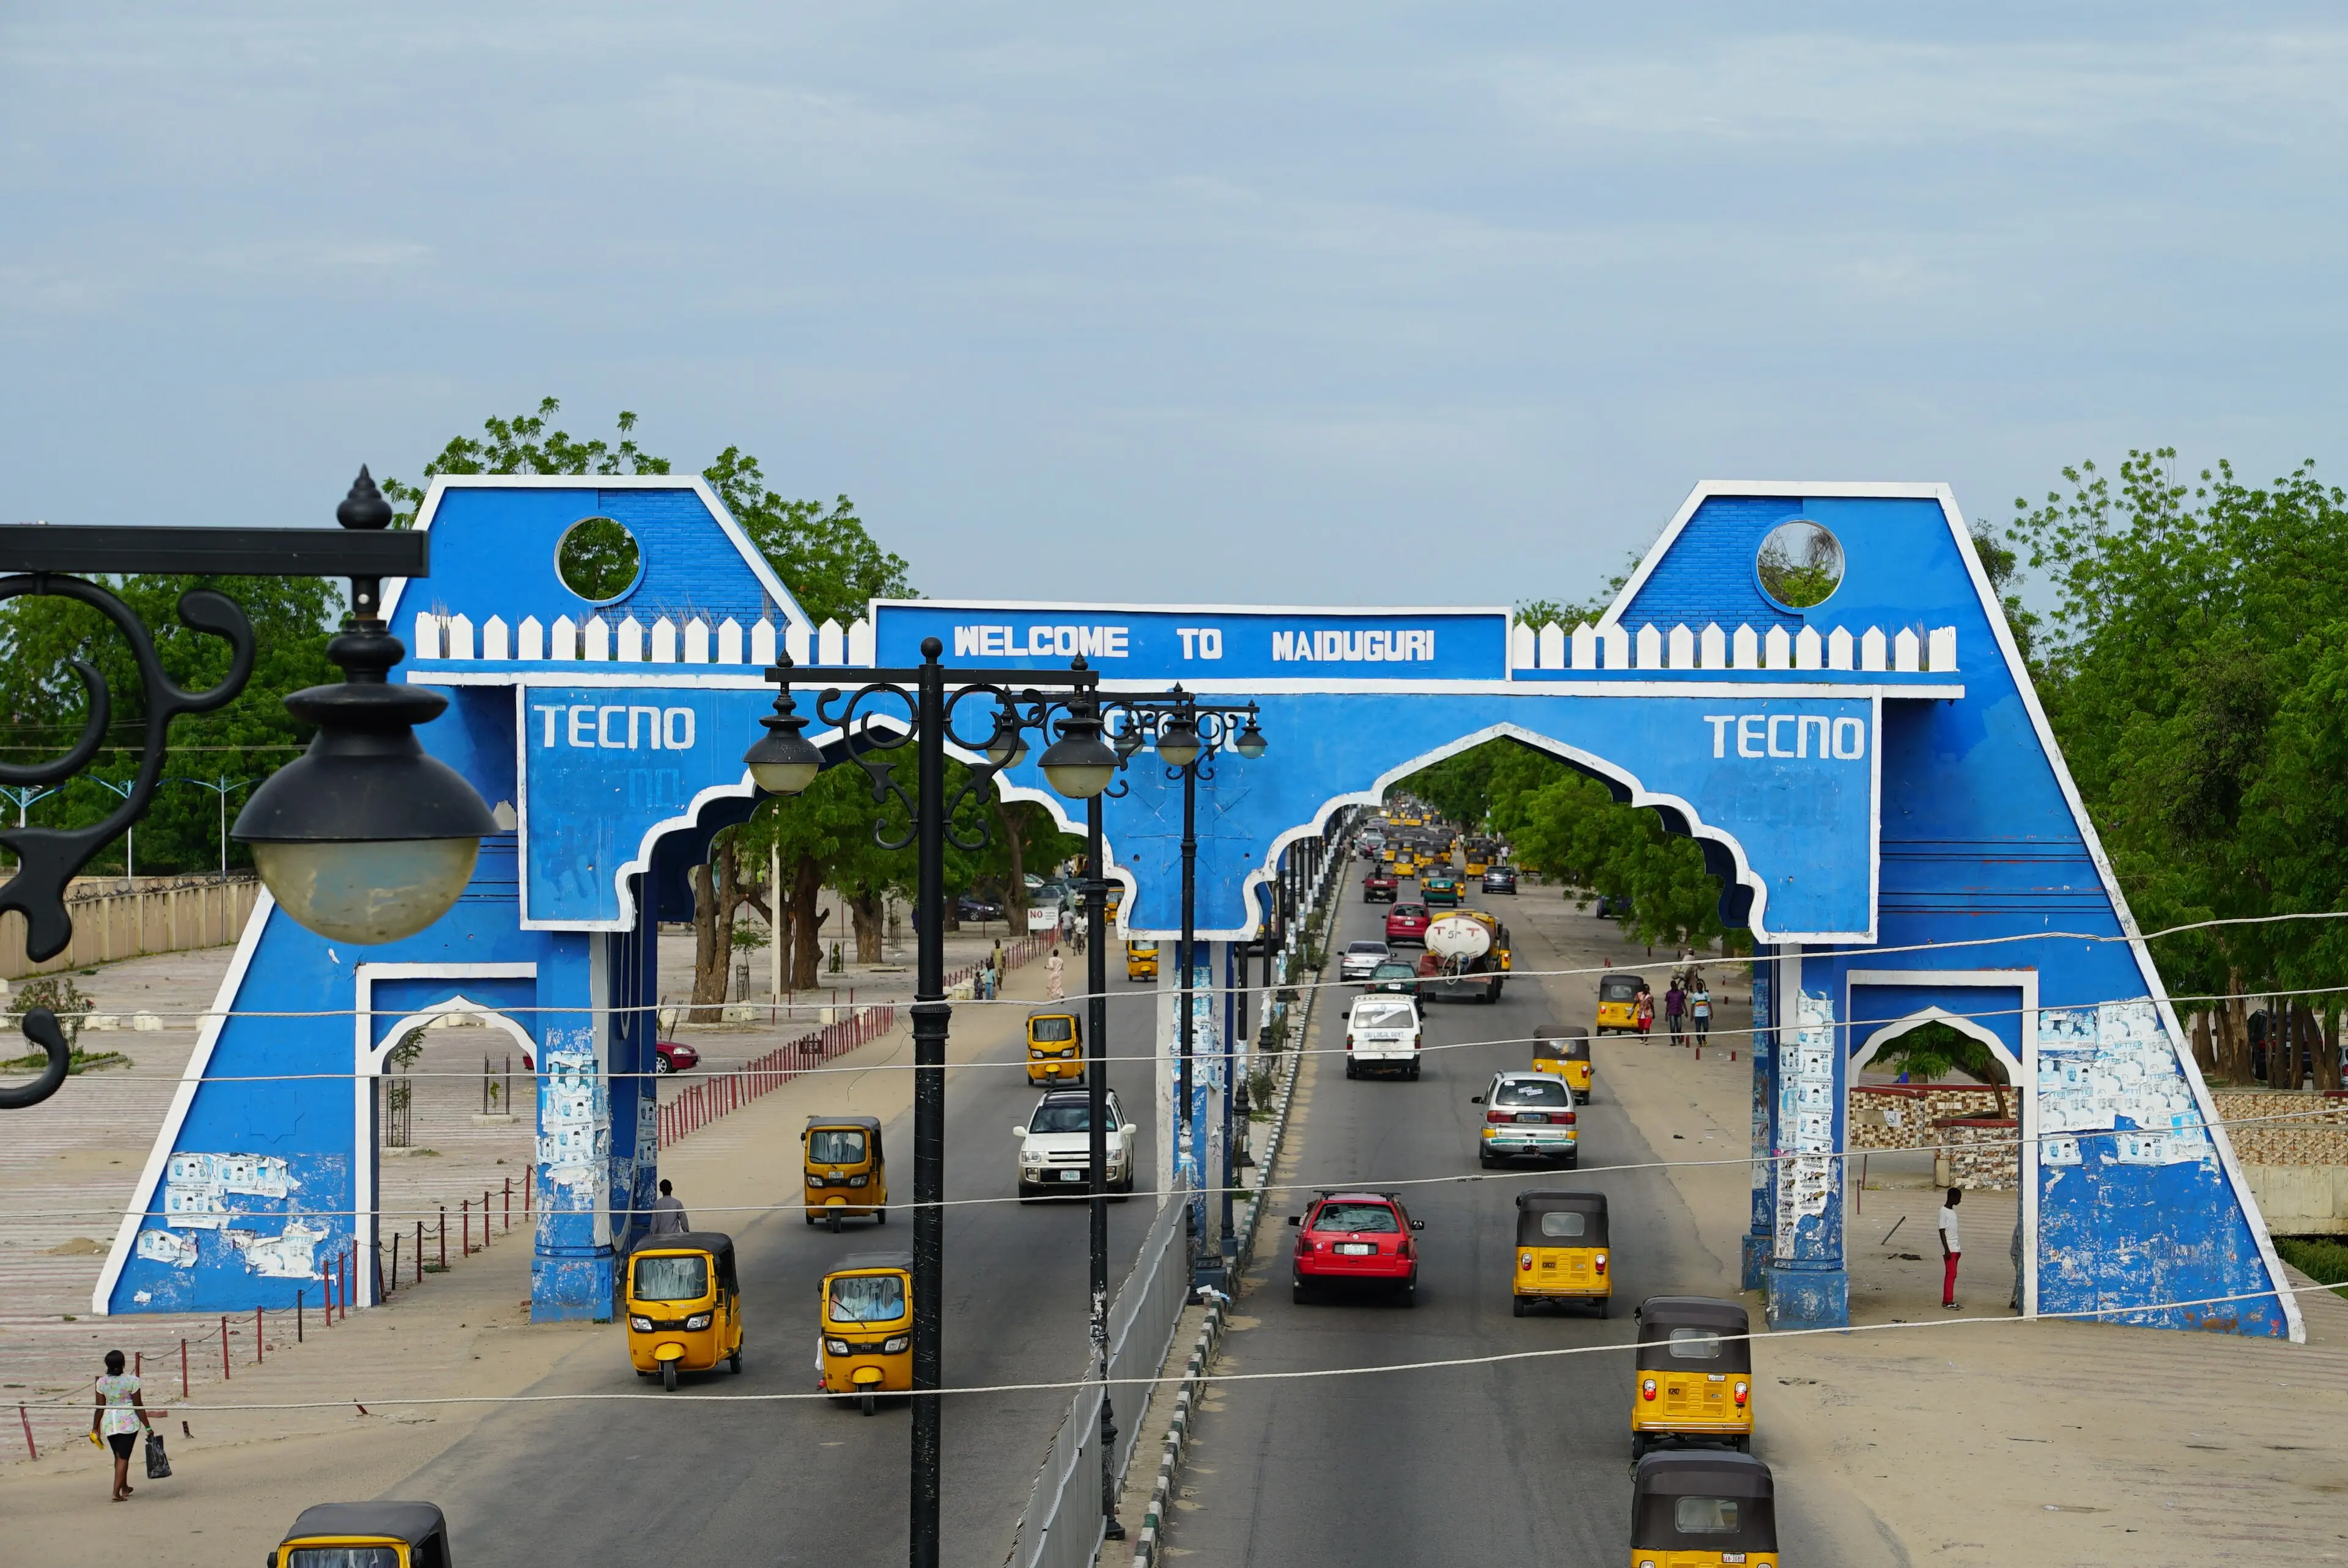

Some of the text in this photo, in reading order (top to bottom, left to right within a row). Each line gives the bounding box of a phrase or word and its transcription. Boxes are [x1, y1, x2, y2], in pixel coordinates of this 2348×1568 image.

[954, 625, 1434, 661] WELCOME TO MAIDUGURI
[533, 705, 695, 750] TECNO
[1703, 715, 1865, 760] TECNO
[1030, 910, 1043, 919] NO
